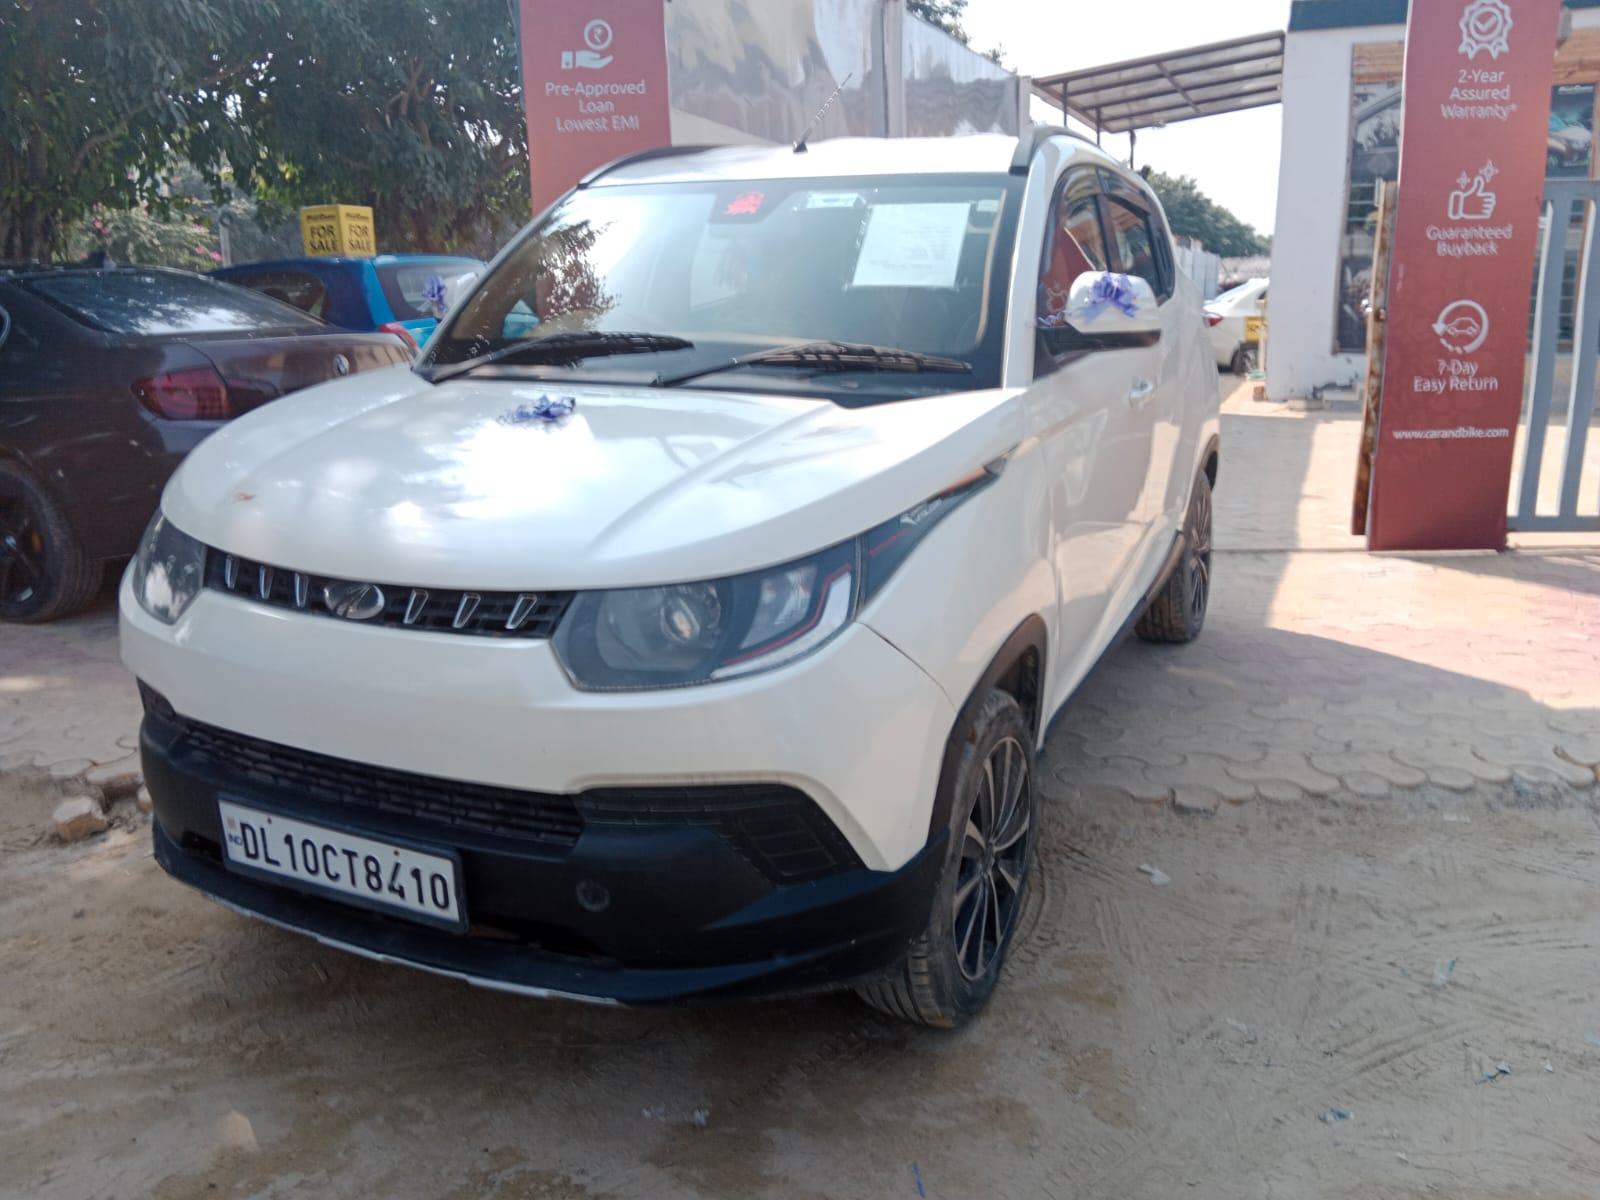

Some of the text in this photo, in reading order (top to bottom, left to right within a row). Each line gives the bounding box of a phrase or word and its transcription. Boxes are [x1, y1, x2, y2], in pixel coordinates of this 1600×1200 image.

[1458, 69, 1504, 83] 2-Year
[545, 80, 646, 97] Pre-Approved
[1450, 85, 1510, 100] Assured
[579, 100, 615, 113] Loan
[555, 115, 640, 132] Lowest EMI
[310, 225, 335, 238] FOR
[348, 224, 369, 237] FOR
[1426, 224, 1513, 240] Guaranteed
[310, 239, 338, 253] SALE
[348, 239, 371, 252] SALE
[1437, 241, 1497, 258] Buyback
[1437, 359, 1478, 376] 7-Day
[1413, 376, 1498, 393] Easy Return
[1393, 427, 1509, 440] www.carandbike.com
[240, 822, 449, 909] DL10CT8410
